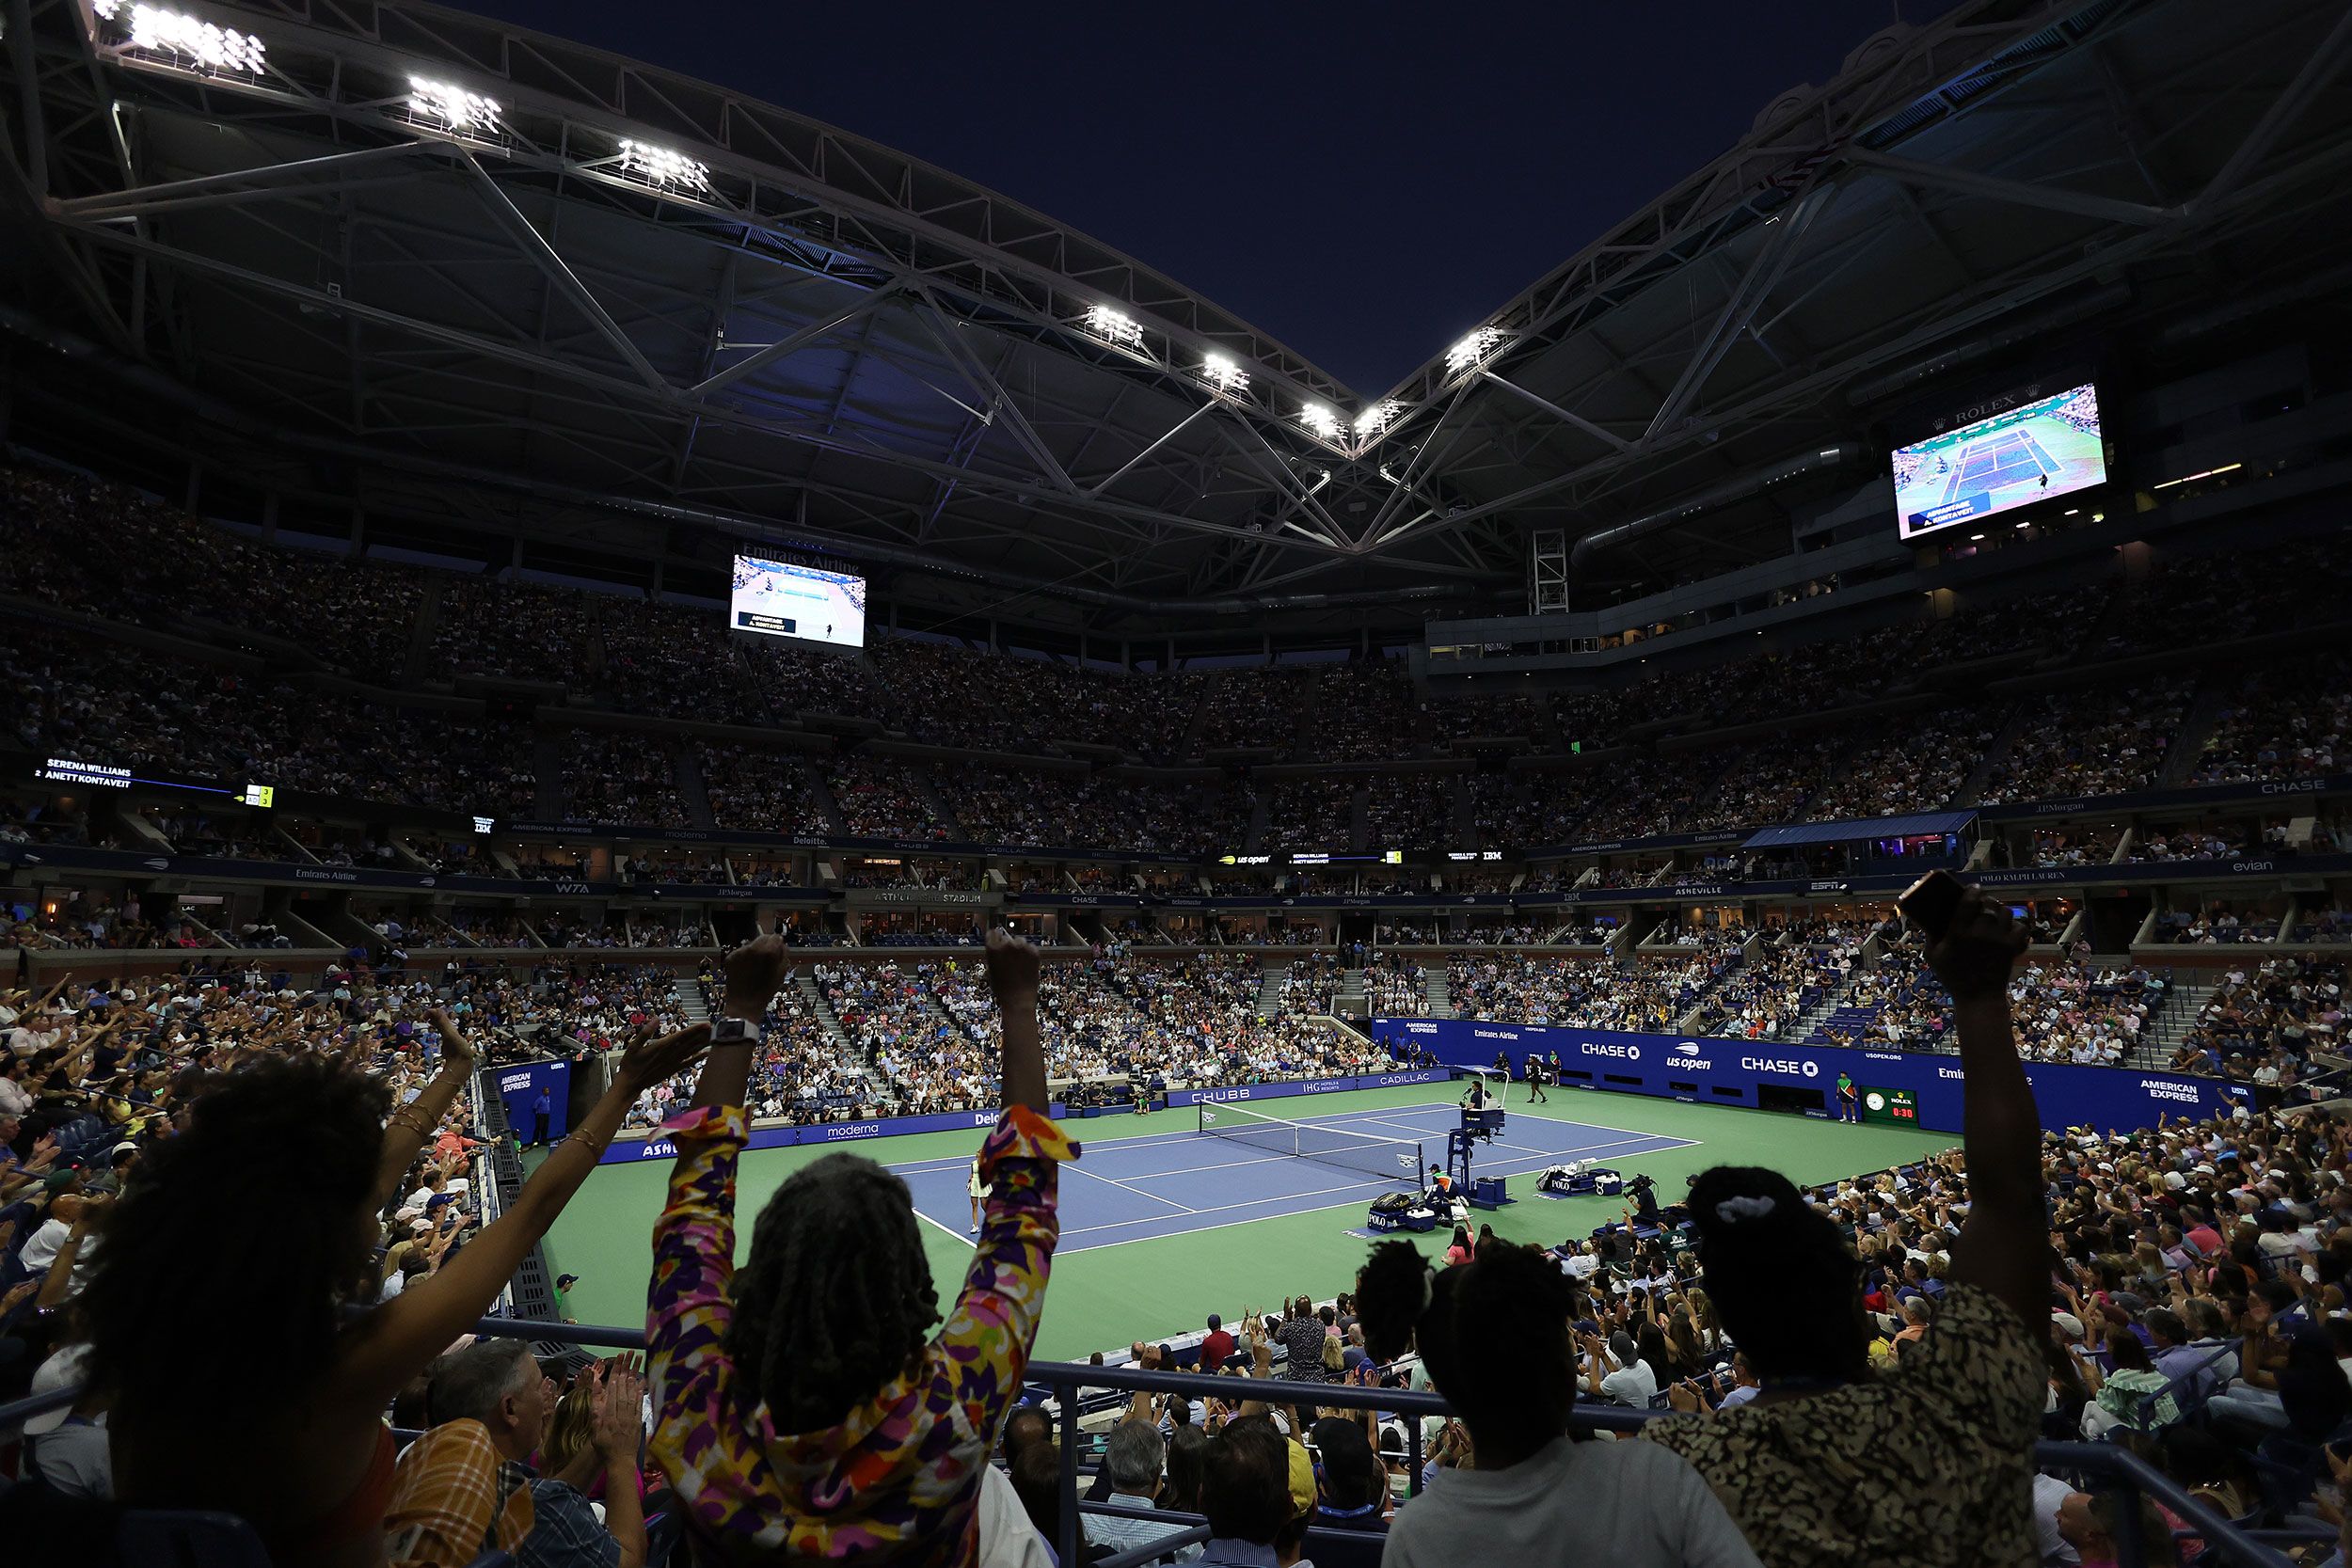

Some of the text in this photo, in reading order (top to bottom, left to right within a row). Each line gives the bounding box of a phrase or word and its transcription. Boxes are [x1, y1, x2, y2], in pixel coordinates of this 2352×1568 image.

[1956, 394, 2015, 423] ROLEX
[743, 543, 859, 575] Emirates Airline
[47, 758, 131, 777] SERENA WILLIAMS
[44, 770, 78, 783] ANETT
[78, 774, 131, 788] KONTAVEIT
[2262, 780, 2326, 794] CHASE
[2036, 803, 2085, 814] J.P.Morgan
[474, 823, 491, 833] IBM
[665, 830, 706, 840] moderna
[793, 836, 827, 846] Deloitte.
[1248, 856, 1269, 864] open
[1483, 851, 1502, 860] IBM
[2233, 860, 2273, 873] evian
[296, 869, 358, 881] Emirates Airline
[1980, 872, 2065, 883] POLO RALPH LAUREN
[555, 883, 589, 894] WTA
[1676, 887, 1723, 895] ASHEVILLE
[943, 895, 981, 903] STADIUM
[1564, 893, 1581, 902] IBM
[1474, 1030, 1518, 1040] Emirates Airline
[1581, 1043, 1626, 1058] CHASE
[1866, 1053, 1902, 1061] USOPEN.ORG
[1666, 1057, 1711, 1071] us open
[1741, 1056, 1800, 1075] CHASE
[501, 1072, 532, 1086] AMERICAN
[1380, 1072, 1430, 1085] CADILLAC
[503, 1081, 532, 1093] EXPRESS
[1303, 1083, 1320, 1093] IHG
[2140, 1080, 2198, 1094] AMERICAN
[2231, 1087, 2249, 1096] USTA
[1192, 1089, 1250, 1103] CHUBB
[2150, 1089, 2199, 1103] EXPRESS
[1893, 1107, 1914, 1118] 0:30
[828, 1123, 879, 1135] moderna
[1551, 1180, 1570, 1191] POLO
[1369, 1213, 1386, 1227] POLO
